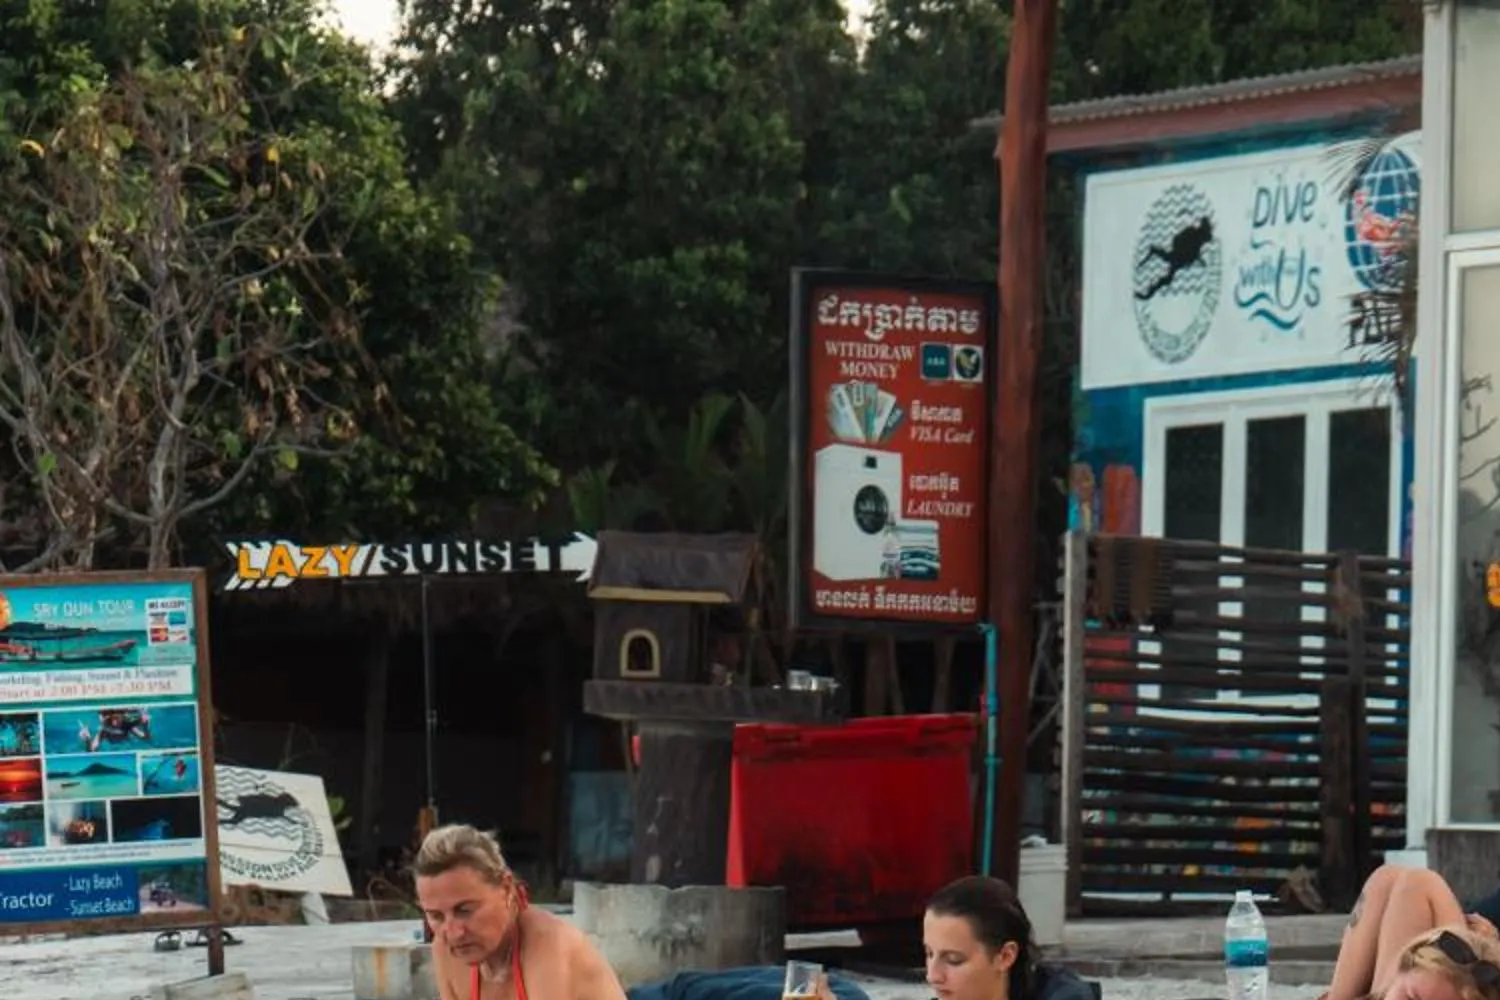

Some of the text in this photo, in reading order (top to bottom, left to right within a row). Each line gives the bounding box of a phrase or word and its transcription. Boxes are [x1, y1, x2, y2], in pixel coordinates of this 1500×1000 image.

[825, 340, 916, 361] WITHDRAW
[839, 361, 899, 380] MONEY
[910, 426, 975, 443] VISA Card
[907, 499, 975, 518] LAUNDRY
[93, 871, 123, 890] Beach
[105, 895, 136, 913] Beach
